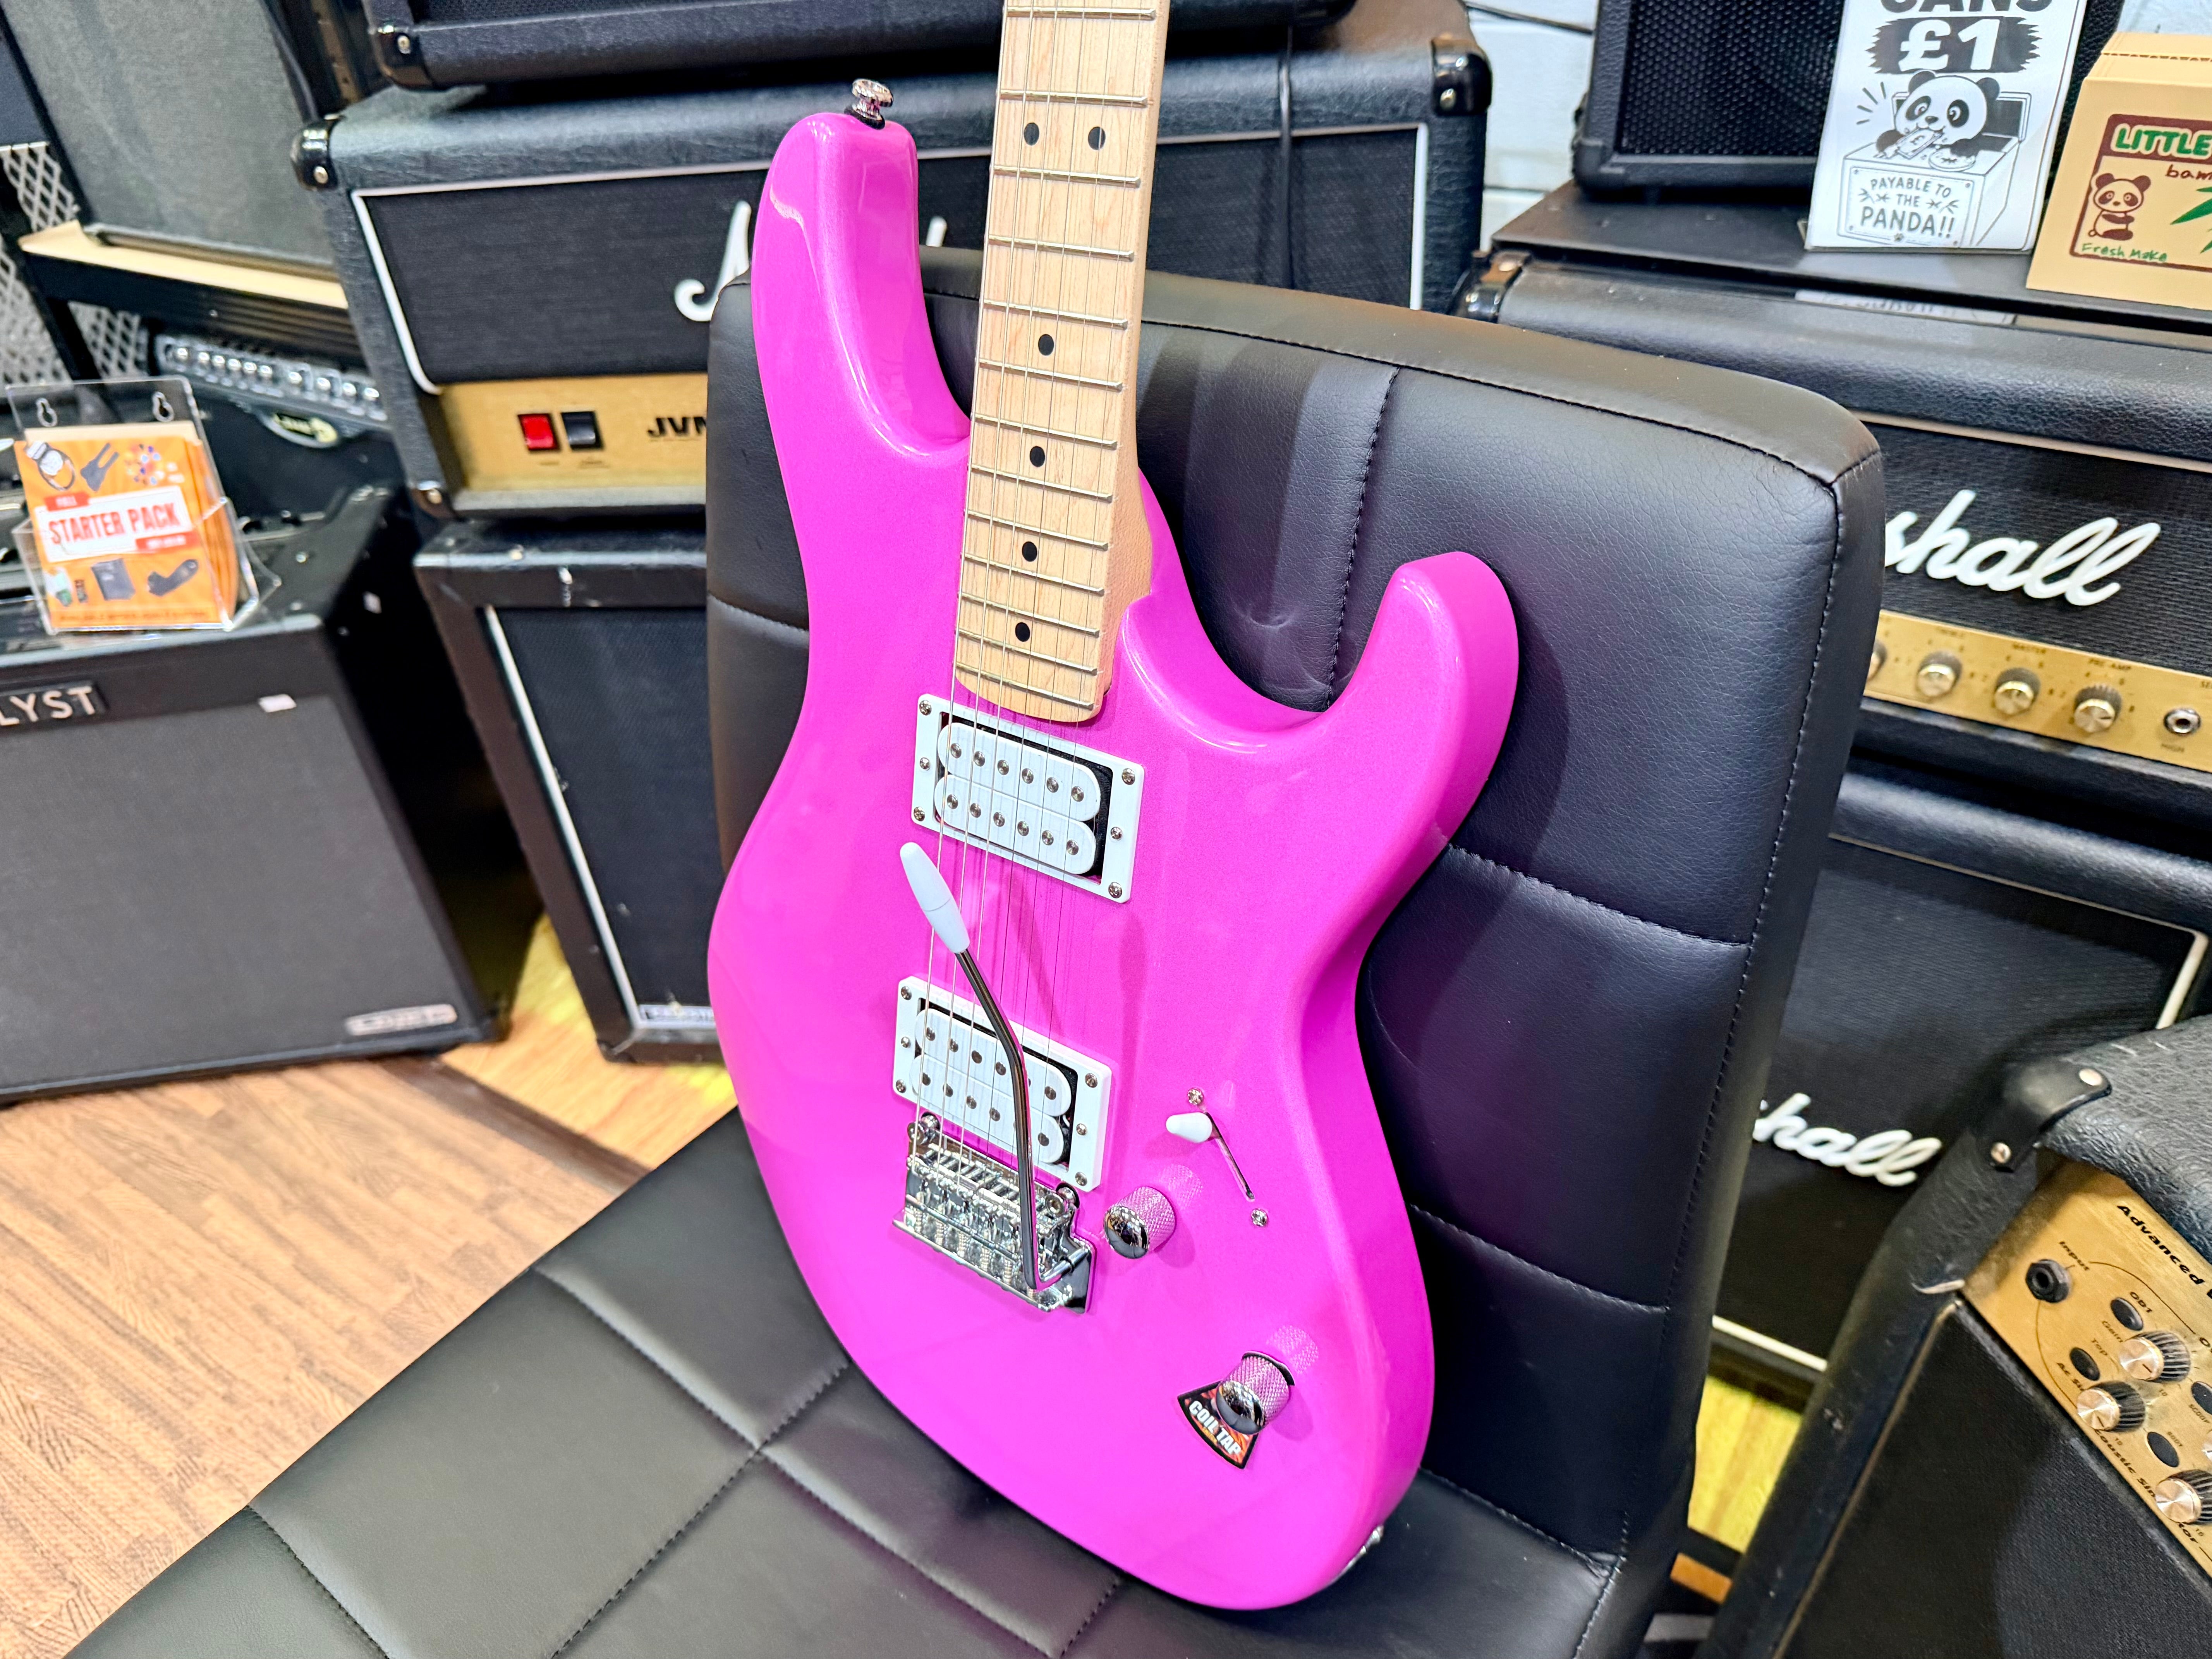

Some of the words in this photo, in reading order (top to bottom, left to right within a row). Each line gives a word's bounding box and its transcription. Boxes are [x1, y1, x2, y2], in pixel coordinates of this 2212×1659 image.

[1898, 19, 2000, 71] £1
[2116, 128, 2212, 156] LITTLE
[1870, 177, 1932, 192] PAYABLE
[1935, 183, 1952, 198] TO
[1896, 193, 1921, 207] THE
[1860, 206, 1954, 239] PANDA!!
[2082, 243, 2125, 257] Fresh
[49, 512, 126, 544] STARTER
[127, 503, 181, 533] PACK
[2060, 1241, 2089, 1271] Input
[2118, 1205, 2205, 1285] Advanced
[2091, 1338, 2108, 1356] Top
[1189, 1400, 1219, 1433] COIL
[1216, 1427, 1242, 1455] TAP
[2095, 1429, 2136, 1474] coustic
